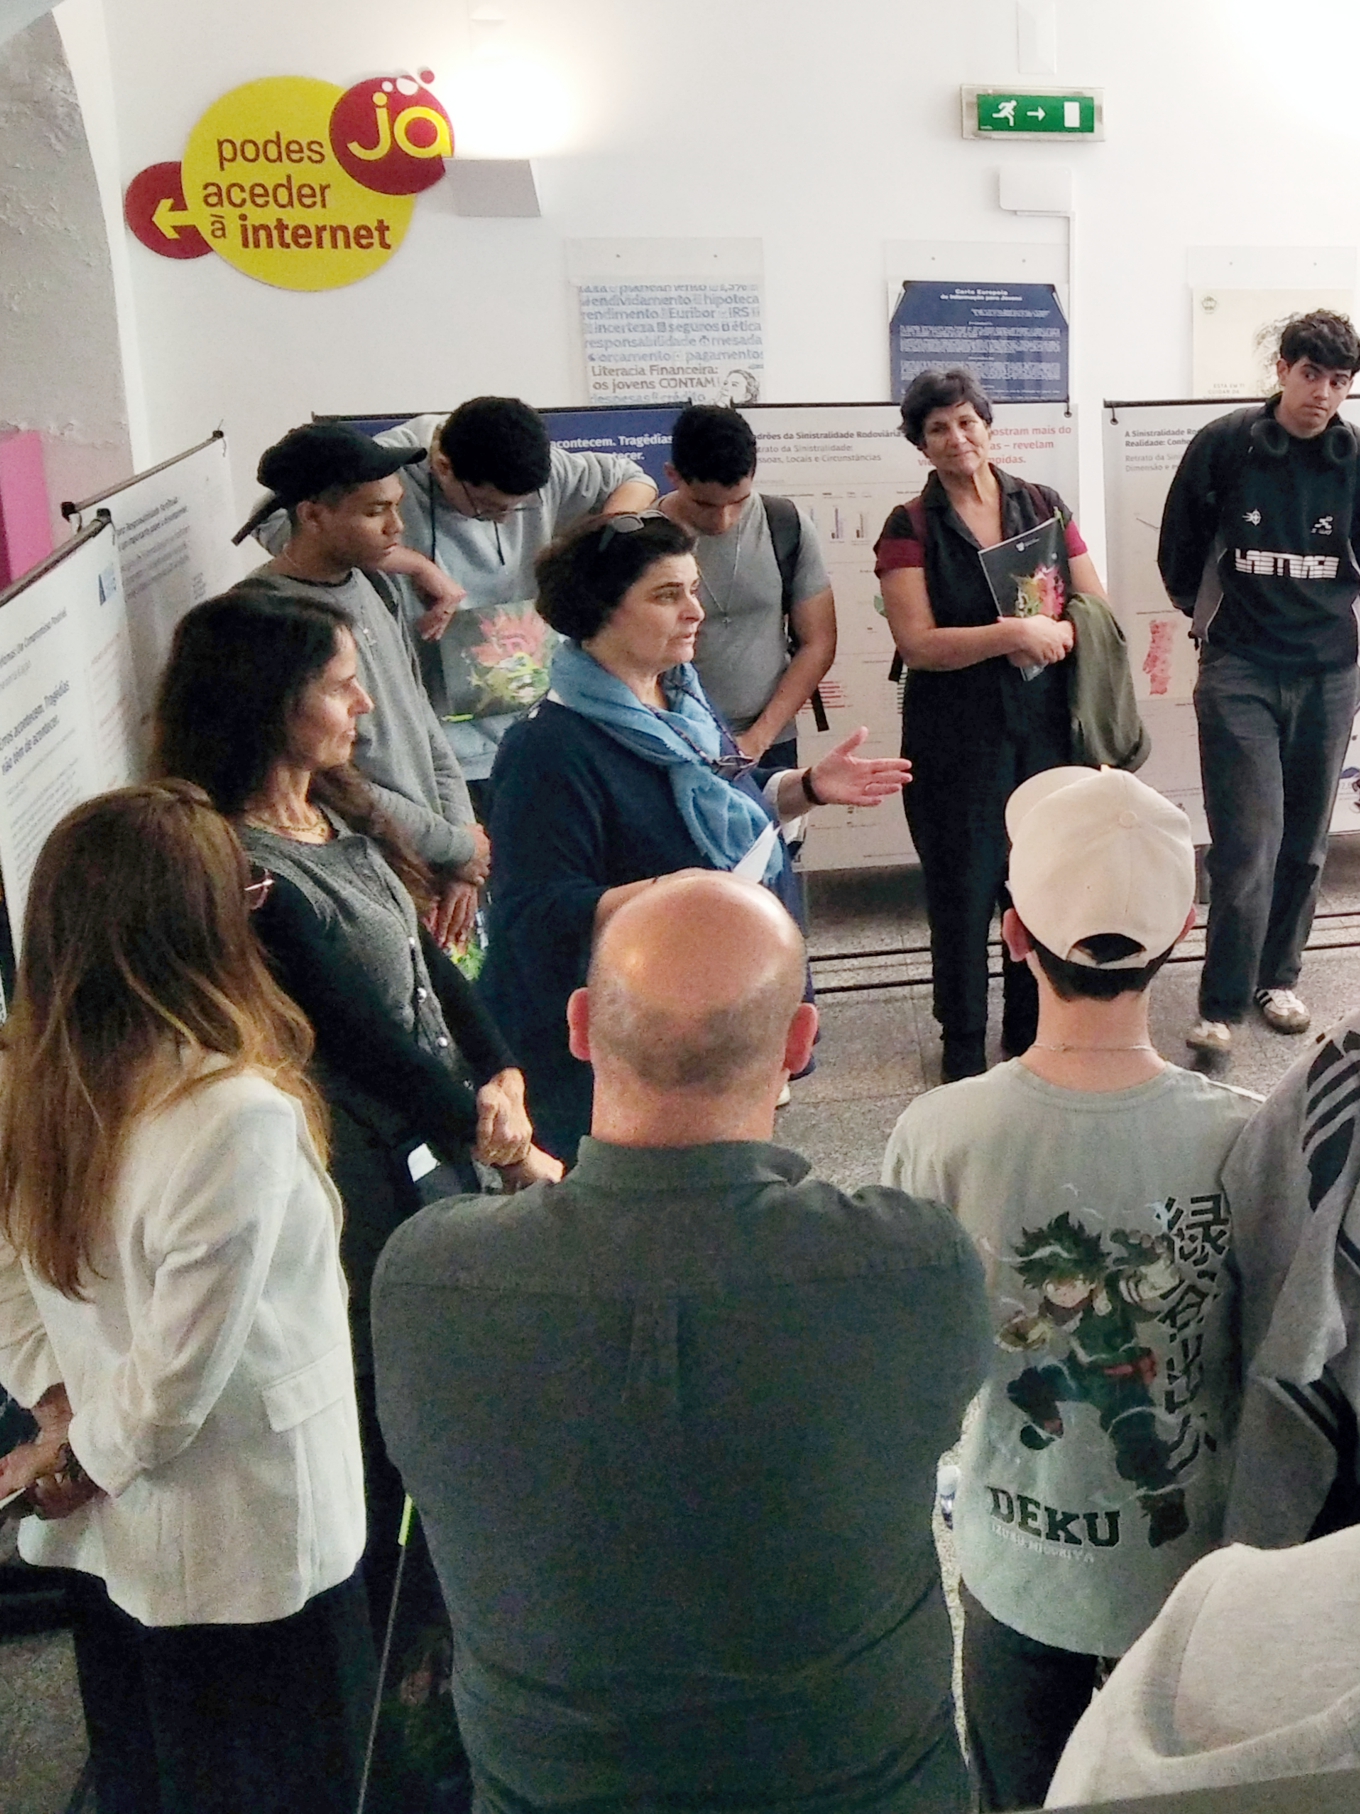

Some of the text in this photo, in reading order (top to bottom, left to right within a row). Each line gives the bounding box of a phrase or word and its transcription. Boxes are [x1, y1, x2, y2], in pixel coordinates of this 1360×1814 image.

[217, 131, 326, 170] podes
[202, 174, 331, 209] aceder
[211, 214, 392, 250] à internet
[595, 293, 760, 308] endividamento hipoteca
[582, 306, 750, 320] rendimento Euribor IRS
[595, 320, 761, 335] incerteza seguros ética
[585, 335, 762, 351] responsabilidade mesada
[600, 351, 671, 364] orçamento
[592, 364, 718, 377] Literacia Financeira:
[592, 380, 608, 390] os
[612, 378, 655, 393] jovens
[783, 432, 795, 440] da
[796, 430, 855, 440] Sinistralidade
[1032, 425, 1056, 435] mais
[1058, 425, 1072, 435] do
[1125, 430, 1131, 438] A
[1132, 429, 1186, 438] Sinistralidade
[1013, 440, 1055, 450] revelam
[1126, 439, 1166, 447] Realidade:
[786, 455, 812, 463] Locais
[985, 1486, 1121, 1547] DEKU
